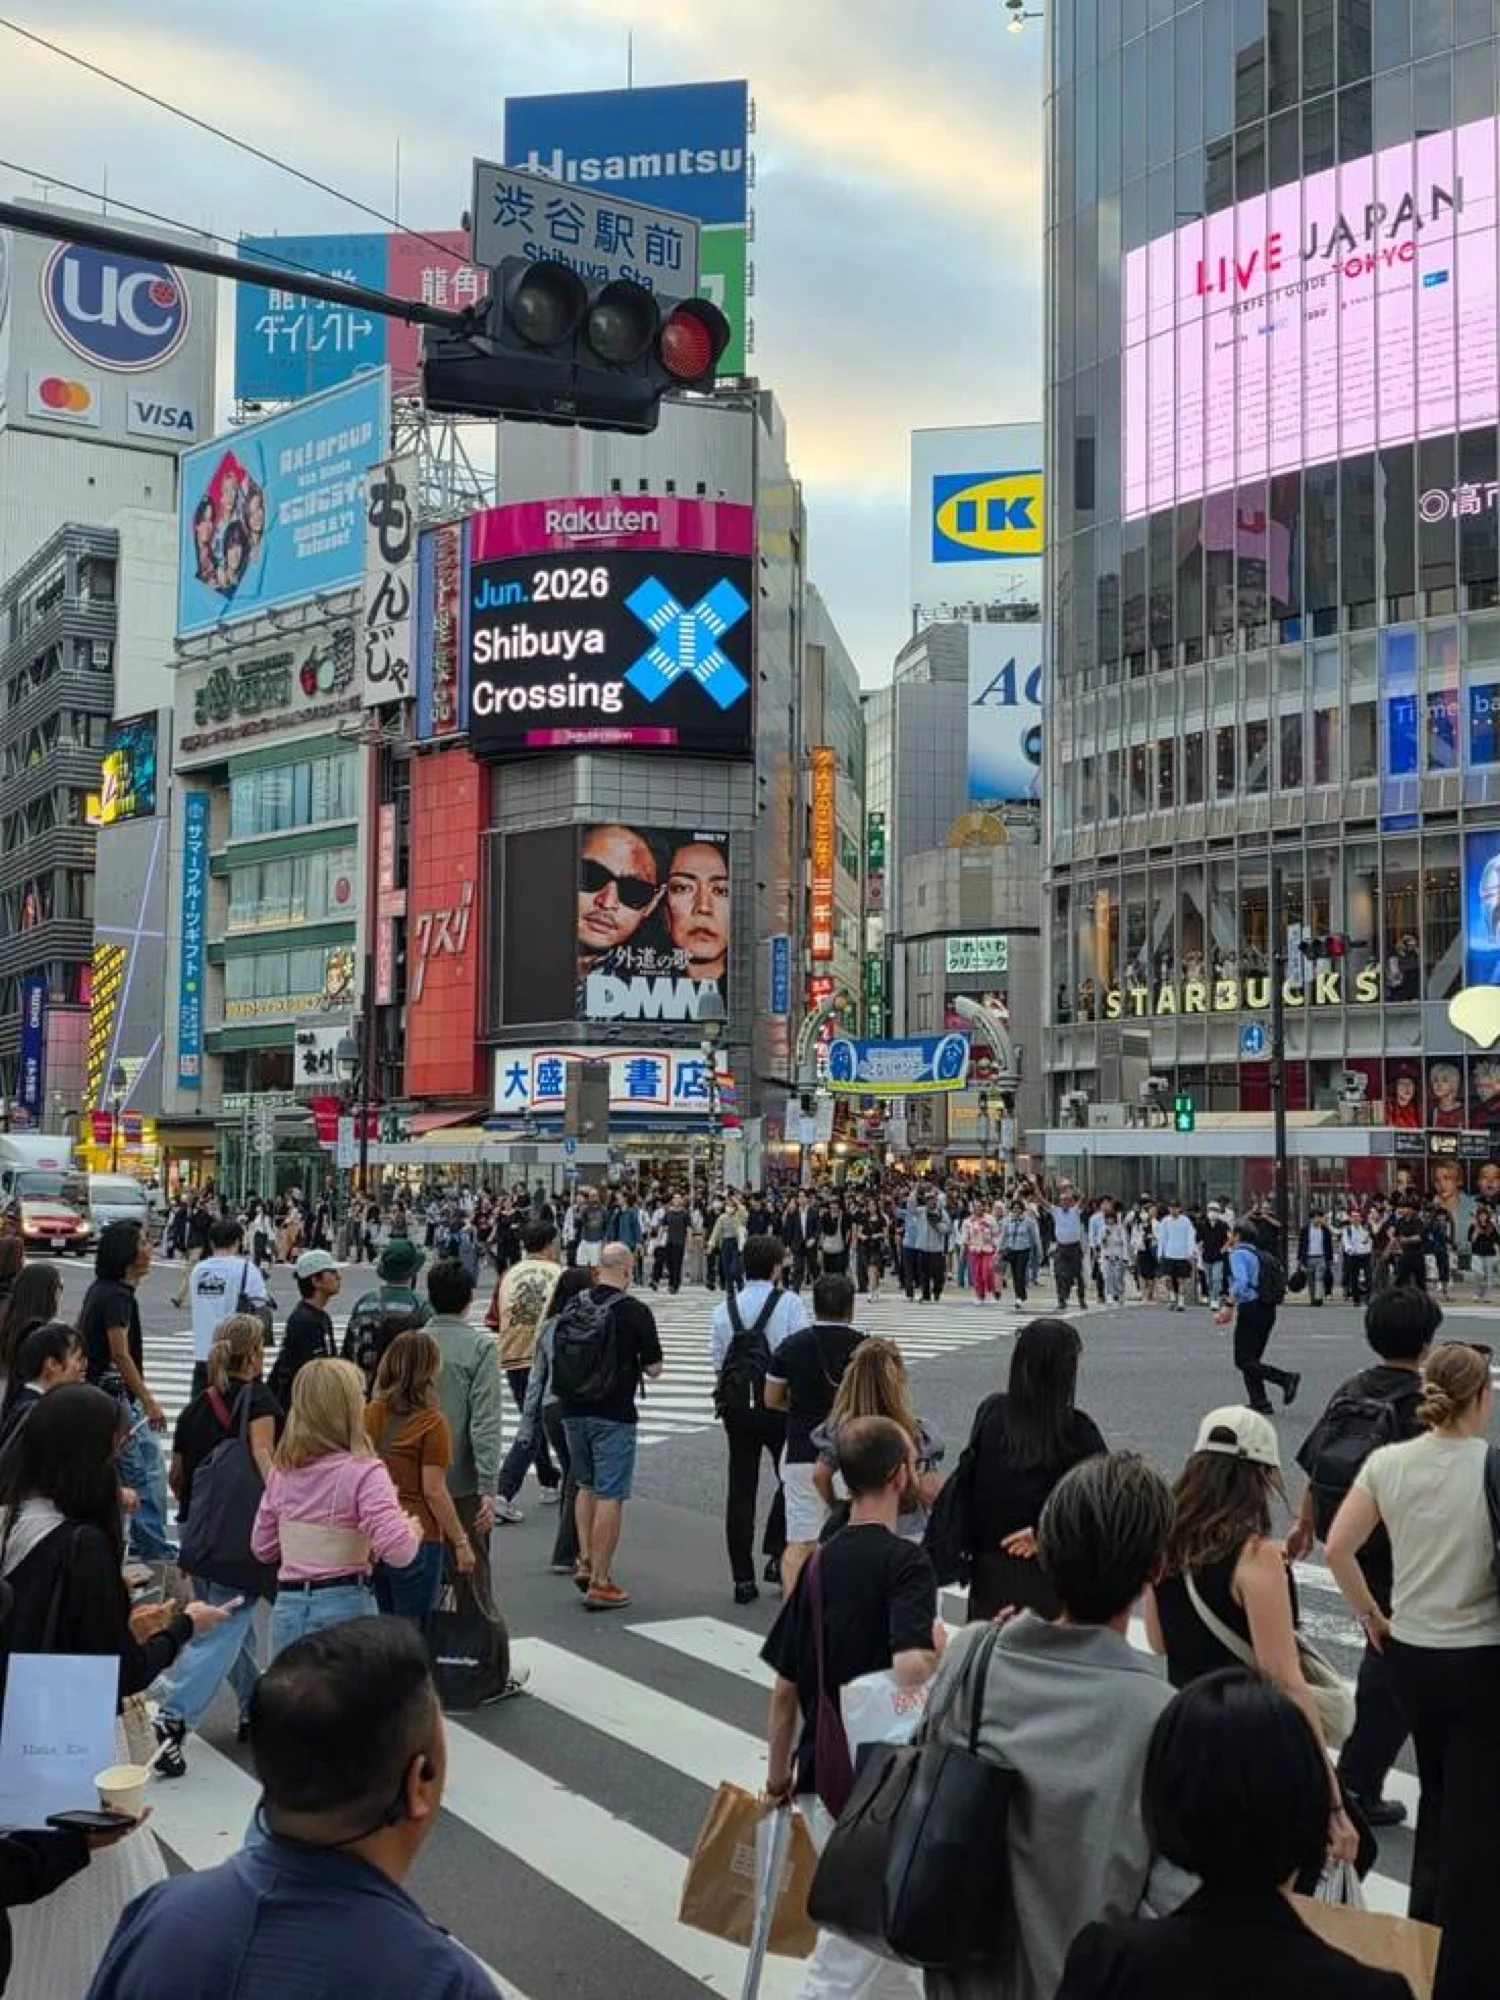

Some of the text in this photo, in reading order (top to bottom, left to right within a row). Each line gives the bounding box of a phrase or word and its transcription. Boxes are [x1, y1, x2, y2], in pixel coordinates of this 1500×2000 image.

[516, 148, 742, 183] Hisamitsu
[493, 182, 684, 270] 渋谷駅前
[1196, 176, 1463, 296] LIVE JAPAN
[1331, 242, 1418, 277] TOKYO
[62, 257, 175, 336] UC
[420, 265, 488, 306] 龍角
[254, 312, 374, 353] ダイレクト
[135, 402, 194, 431] VISA
[545, 507, 660, 535] Rakuten
[368, 465, 412, 693] もんじゃ
[474, 567, 611, 610] Jun. 2026
[472, 623, 606, 664] Shibuya
[472, 673, 625, 716] Crossing
[410, 880, 475, 1005] クスリ
[1106, 971, 1380, 1019] STARBUCKS
[504, 1057, 711, 1099] 大盛書店
